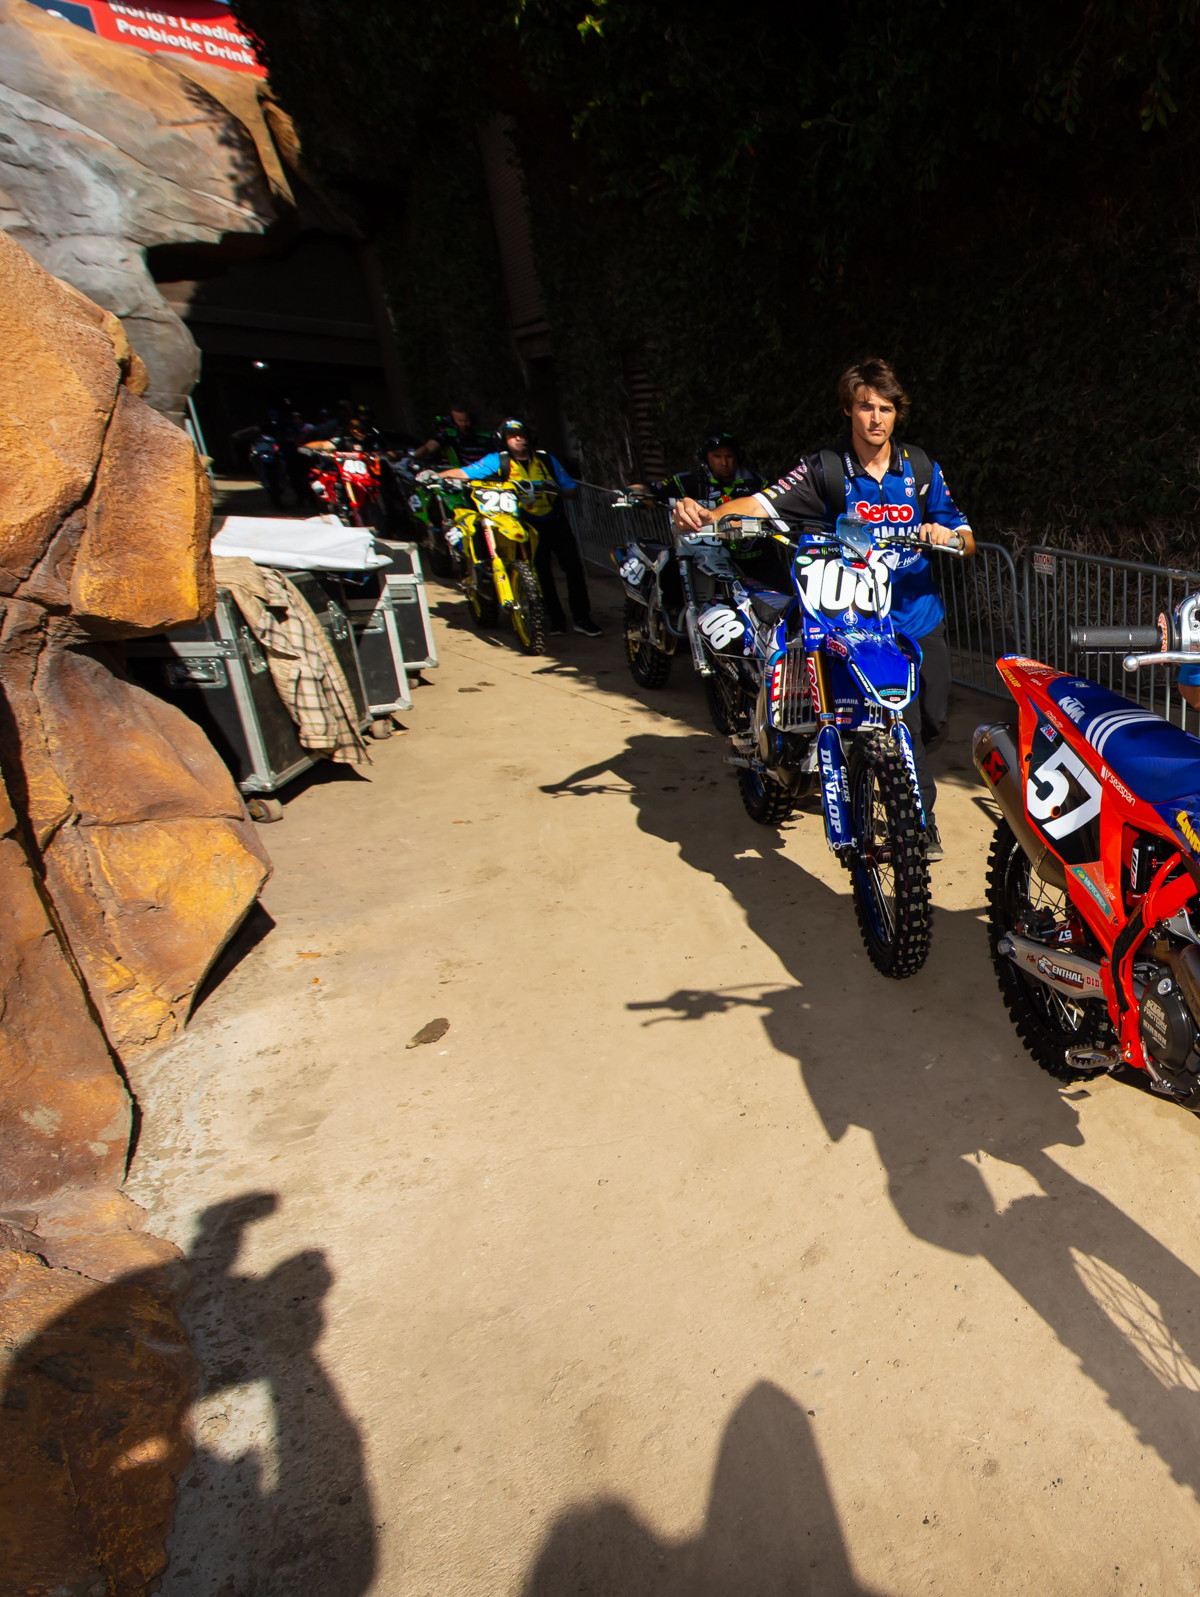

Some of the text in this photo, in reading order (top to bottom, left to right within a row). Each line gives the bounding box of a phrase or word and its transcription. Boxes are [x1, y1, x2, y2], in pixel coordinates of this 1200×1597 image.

[115, 18, 255, 66] Probiotic Drink
[481, 490, 518, 513] 26
[855, 500, 914, 523] Serco
[800, 552, 889, 612] 108
[1057, 695, 1086, 724] KTM
[1027, 742, 1102, 841] 57
[1108, 775, 1136, 807] seaspan
[1037, 955, 1084, 984] RENTHAL
[1146, 1000, 1165, 1021] KTM
